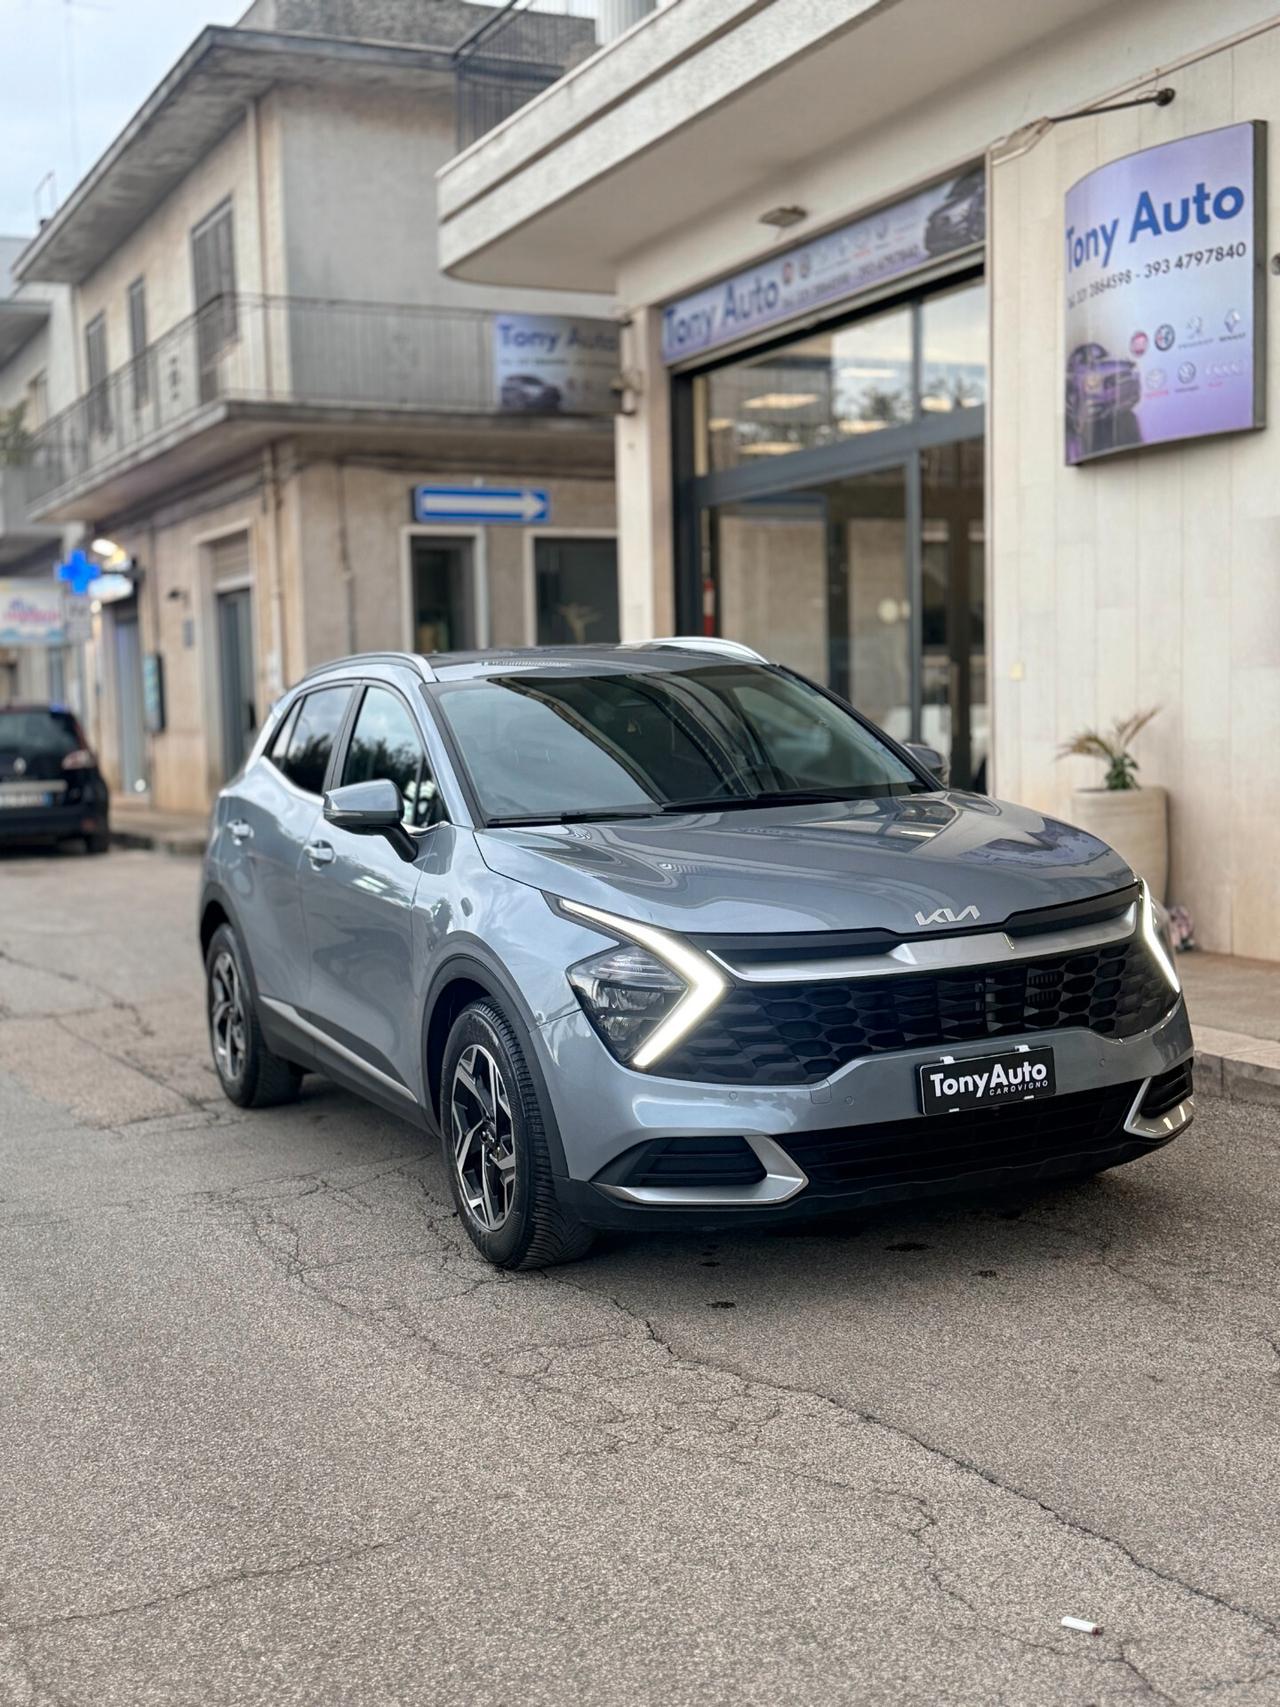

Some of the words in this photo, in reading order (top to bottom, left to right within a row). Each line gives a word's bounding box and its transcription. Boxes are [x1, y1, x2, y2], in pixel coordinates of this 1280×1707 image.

[1066, 218, 1119, 273] Tony
[1129, 183, 1245, 243] Auto
[1144, 259, 1170, 279] 393
[1174, 241, 1247, 271] 4797840
[664, 304, 717, 349] Tony
[721, 277, 779, 327] Auto
[499, 324, 561, 353] Tony
[989, 1080, 1048, 1096] CAROVIGNO
